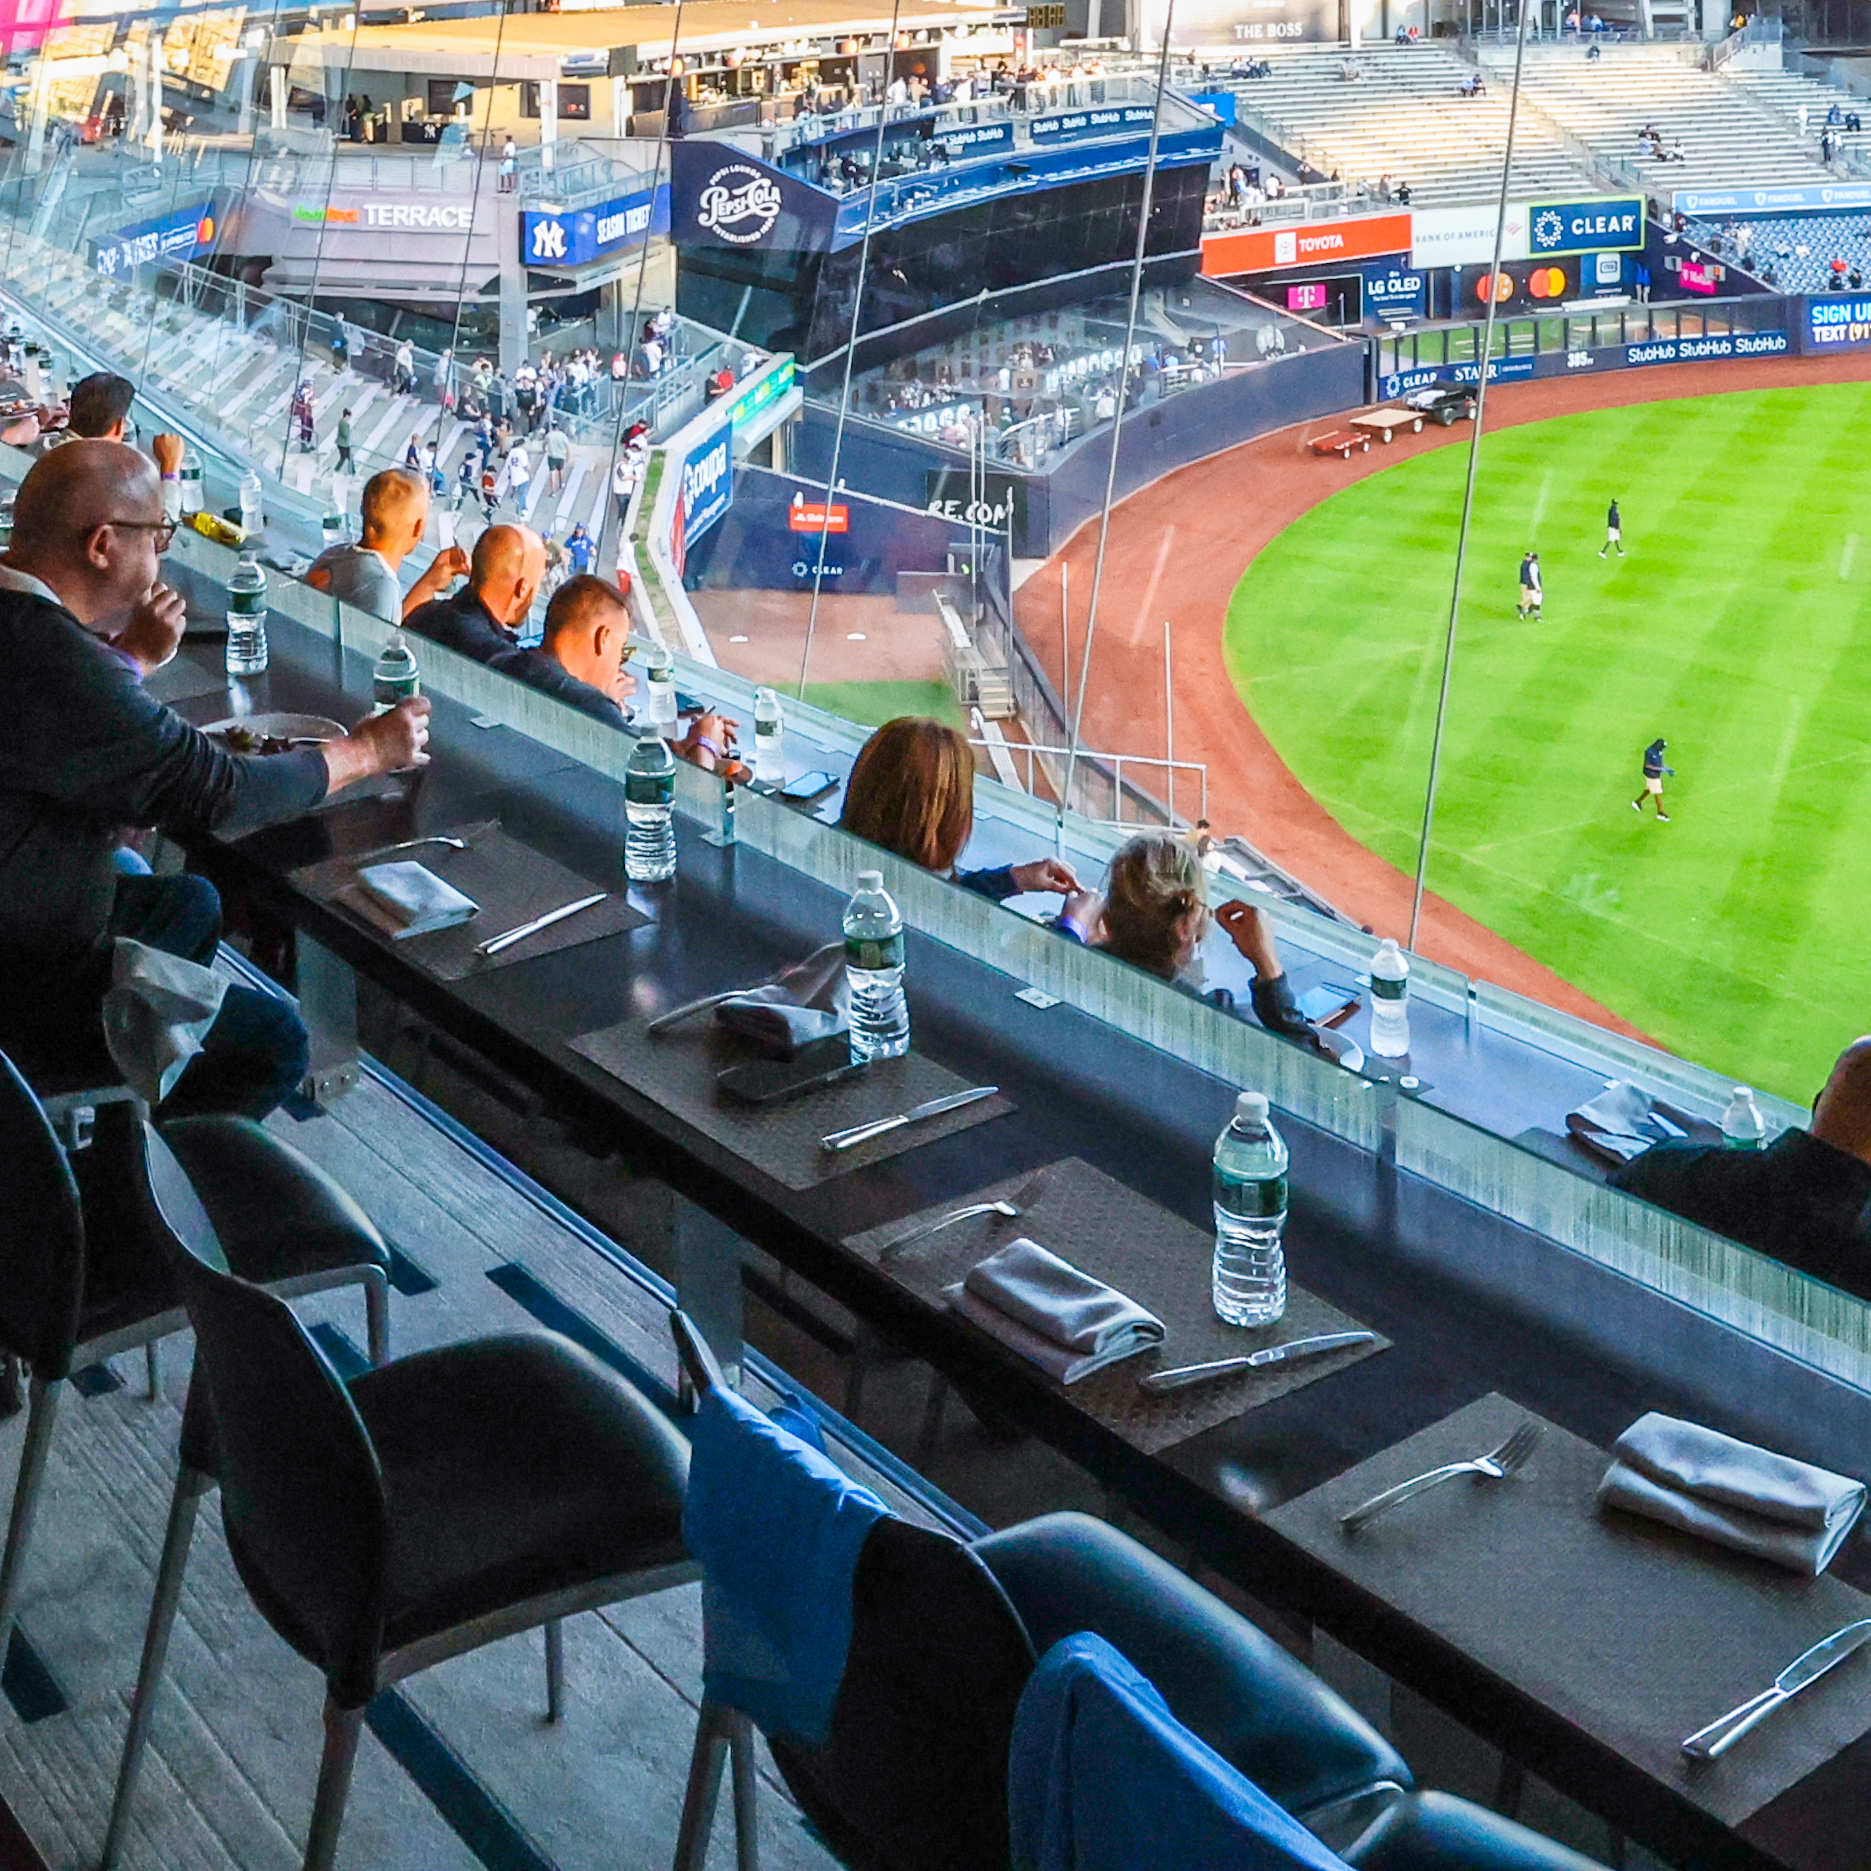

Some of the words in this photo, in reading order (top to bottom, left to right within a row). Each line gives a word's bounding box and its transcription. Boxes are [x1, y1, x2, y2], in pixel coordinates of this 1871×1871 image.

[1234, 24, 1264, 40] THE
[1266, 22, 1303, 38] BOSS
[1091, 112, 1121, 125] StubHub
[1125, 109, 1155, 122] StubHub
[362, 203, 474, 229] TERRACE
[1570, 214, 1634, 237] CLEAR
[597, 213, 625, 245] SEASON
[1415, 233, 1443, 246] BANK
[1443, 230, 1457, 241] OF
[1457, 228, 1499, 240] AMERIC
[1298, 233, 1345, 254] TOYOTA
[1367, 279, 1386, 296] LG
[1387, 276, 1421, 294] OLED
[1812, 304, 1852, 324] SIGN
[1812, 325, 1848, 343] TEXT
[1567, 351, 1588, 368] 385
[1627, 345, 1677, 364] StubHub
[1679, 340, 1732, 359] StubHub
[1734, 336, 1787, 355] StubHub
[1402, 371, 1437, 389] CLEAR
[693, 441, 727, 499] coupa
[811, 565, 843, 576] CEAR
